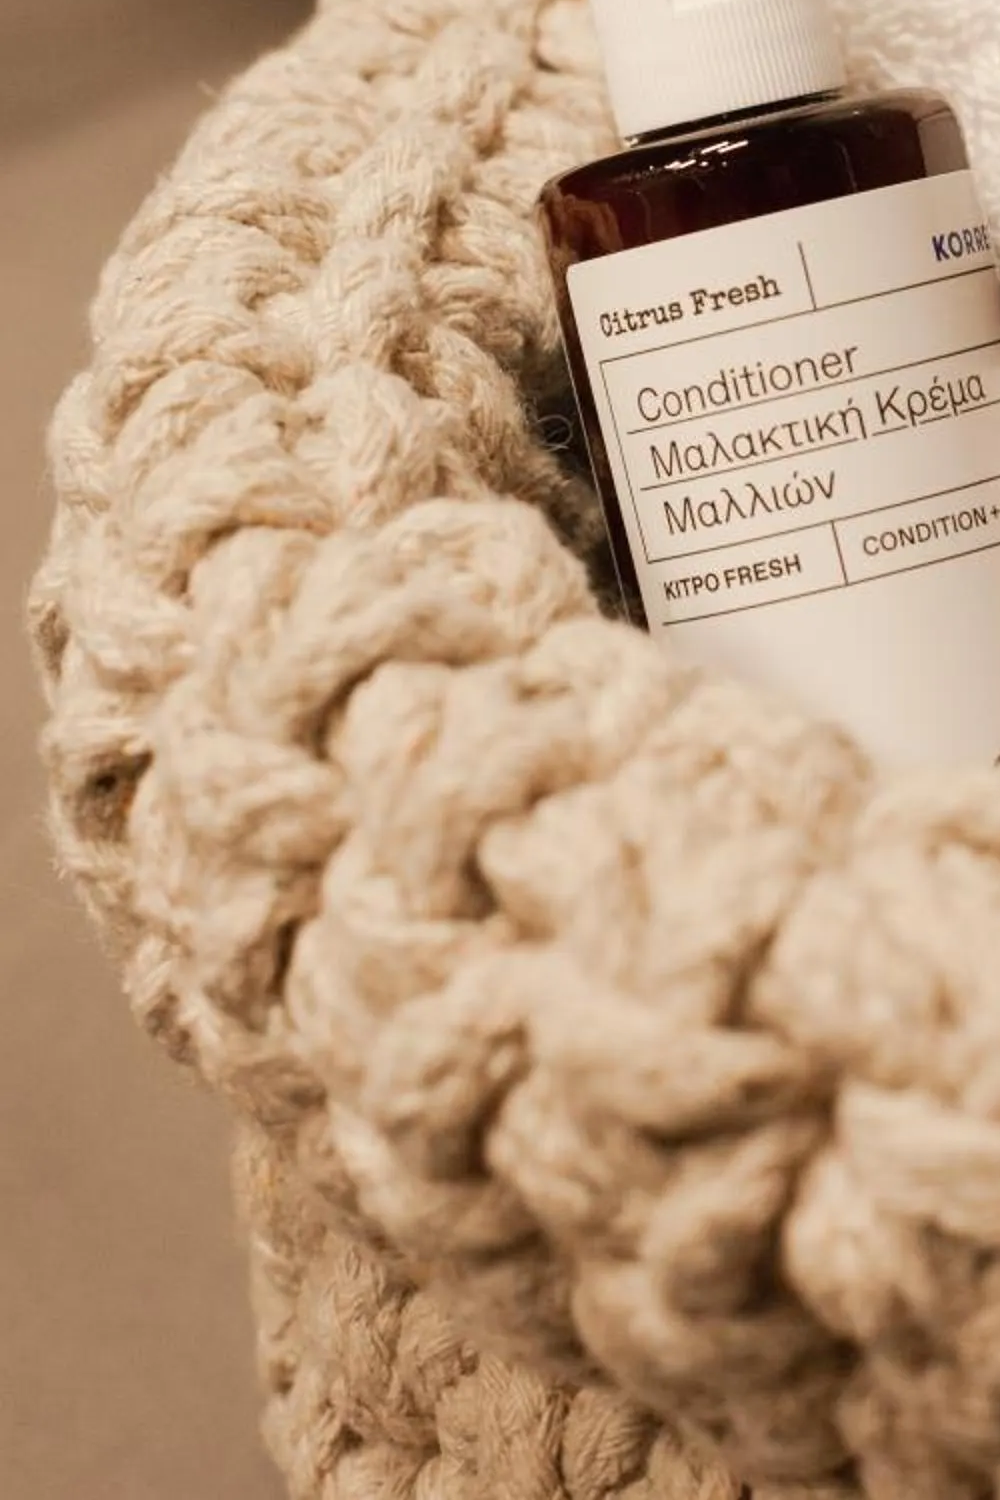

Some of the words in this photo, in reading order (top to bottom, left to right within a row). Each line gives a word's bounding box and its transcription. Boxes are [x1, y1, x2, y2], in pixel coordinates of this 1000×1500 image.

[932, 224, 990, 261] KORRE
[599, 301, 684, 337] Citrus
[689, 275, 782, 316] Fresh
[636, 345, 859, 423] Conditioner
[650, 398, 867, 480] Μαλακτική
[876, 372, 986, 427] Κρέμα
[664, 470, 837, 536] Μαλλιών
[863, 506, 988, 556] CONDITION
[724, 553, 802, 590] FRESH
